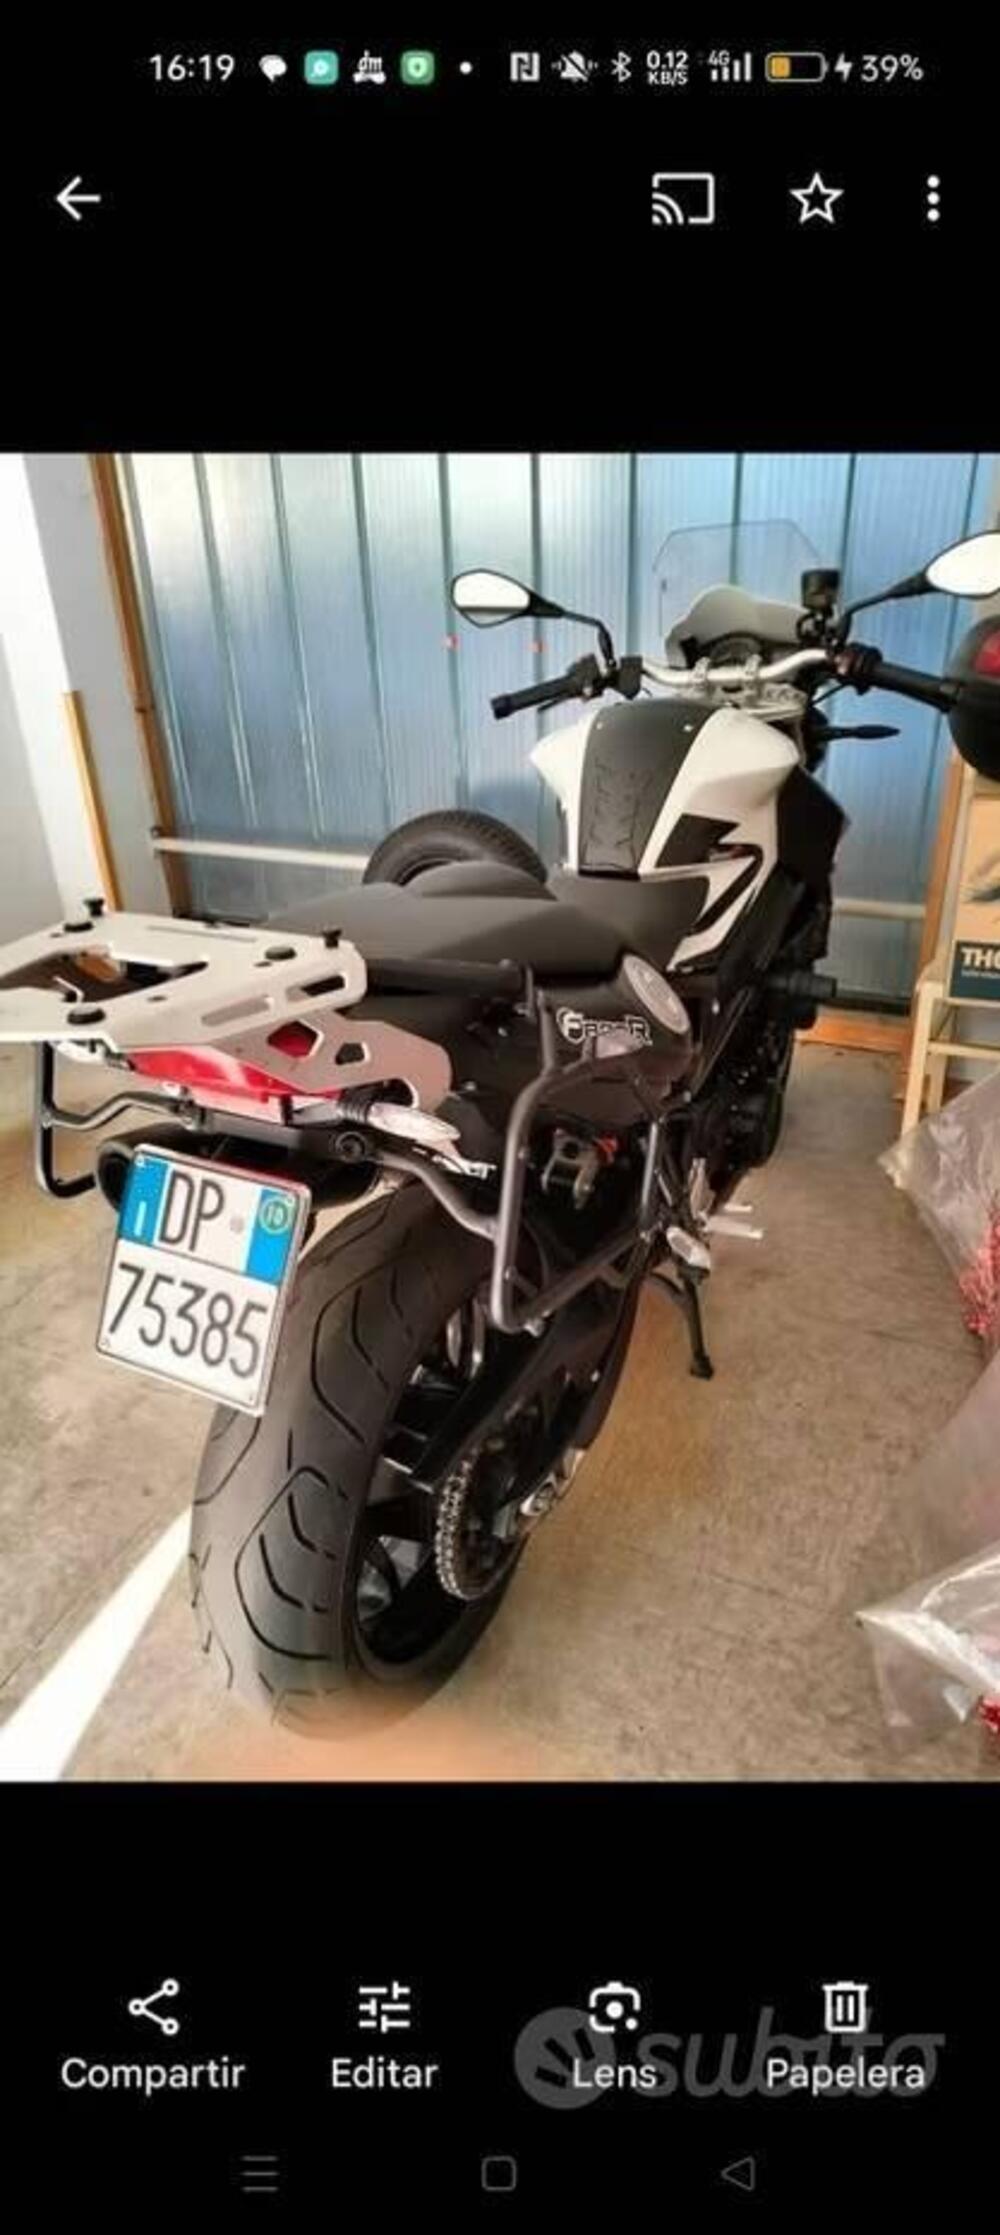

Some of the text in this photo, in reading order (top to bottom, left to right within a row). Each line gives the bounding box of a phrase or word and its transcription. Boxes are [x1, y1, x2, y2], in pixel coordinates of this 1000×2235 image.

[151, 55, 234, 81] 16:19
[646, 50, 689, 69] 0.12
[708, 50, 730, 66] 4G
[861, 54, 924, 82] 39%
[649, 70, 688, 86] KB/S
[160, 1169, 225, 1252] DP
[109, 1262, 268, 1379] 75385
[61, 2056, 245, 2096] Compartir
[332, 2056, 438, 2088] Editar
[573, 2058, 657, 2089] Lens
[767, 2055, 925, 2095] Papelera
